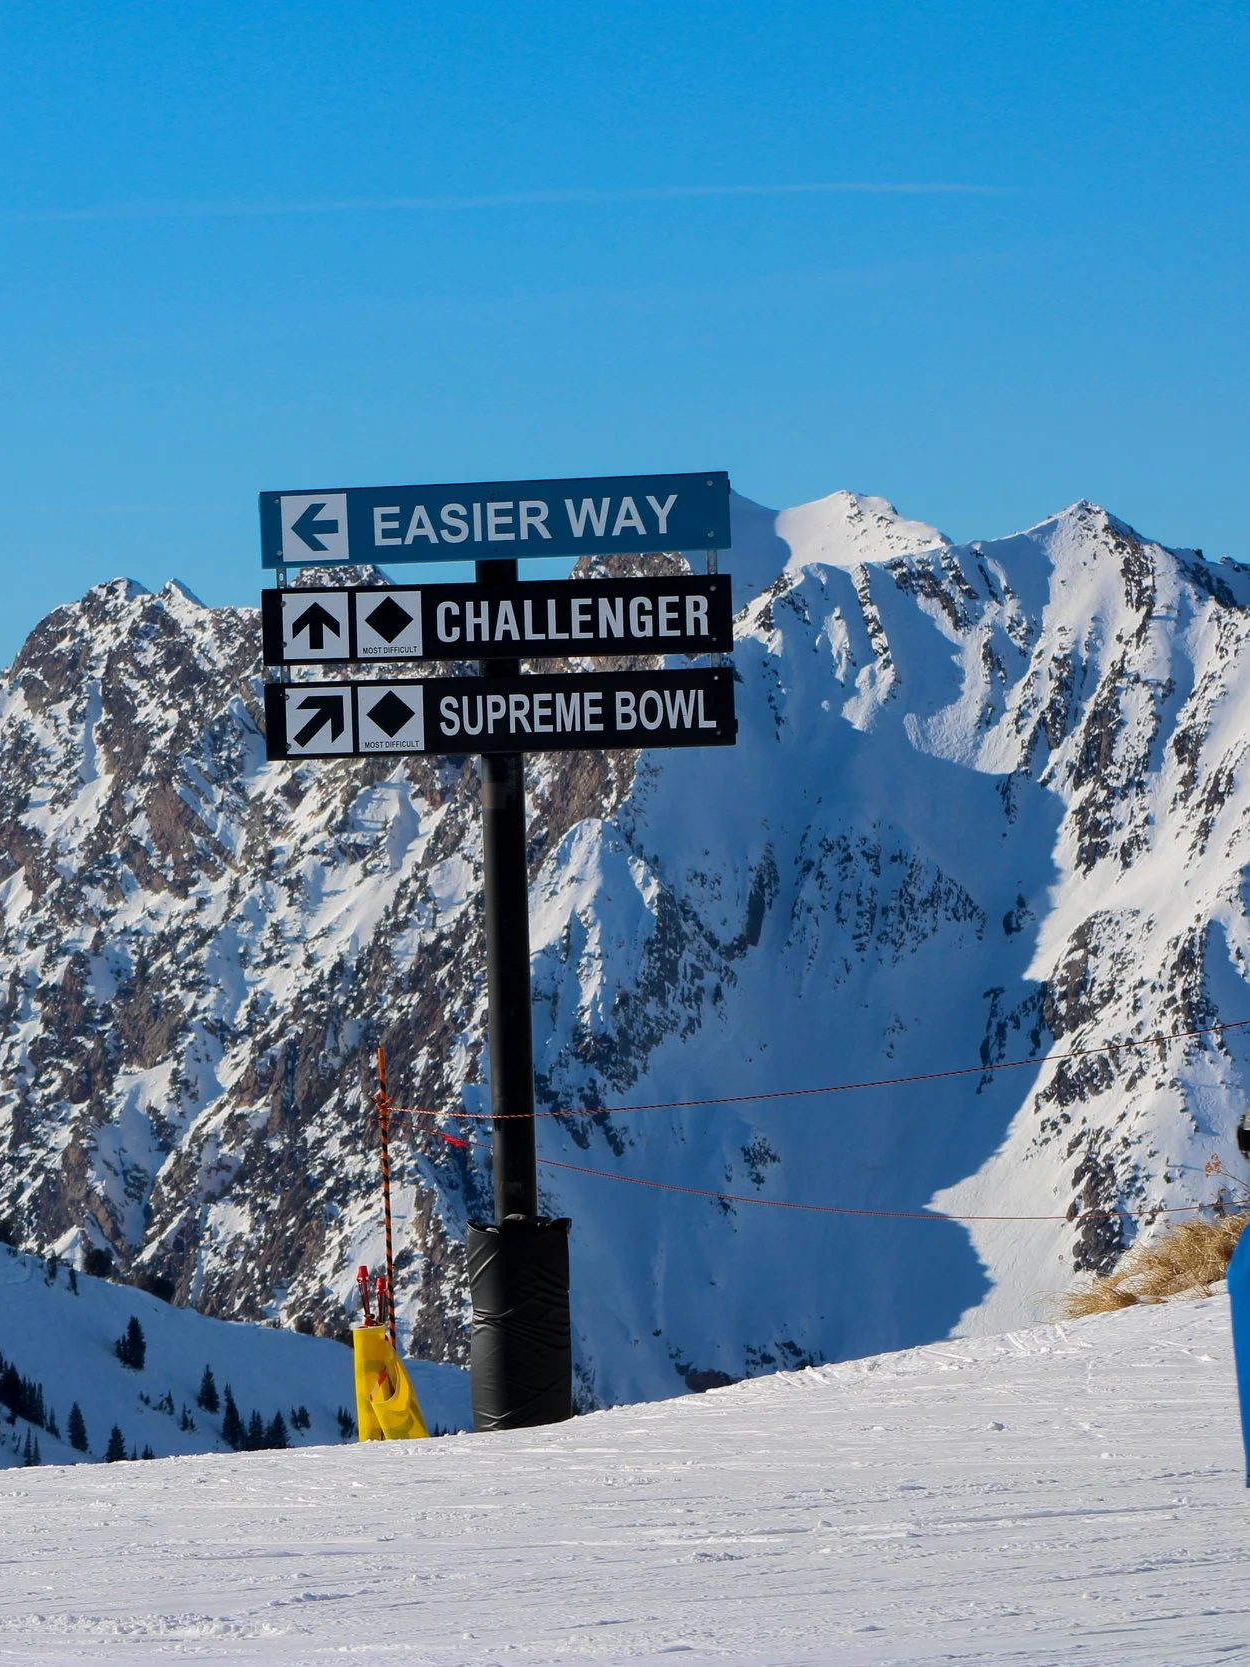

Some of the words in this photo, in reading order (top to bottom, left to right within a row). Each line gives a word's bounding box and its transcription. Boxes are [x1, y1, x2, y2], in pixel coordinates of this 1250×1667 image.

[373, 500, 552, 546] EASIER
[564, 494, 679, 537] WAY
[436, 595, 709, 643] CHALLENGER
[384, 646, 418, 654] DIFFICULT
[439, 692, 605, 736] SUPREME
[615, 689, 717, 731] BOWL
[385, 740, 419, 748] DIFFICULT
